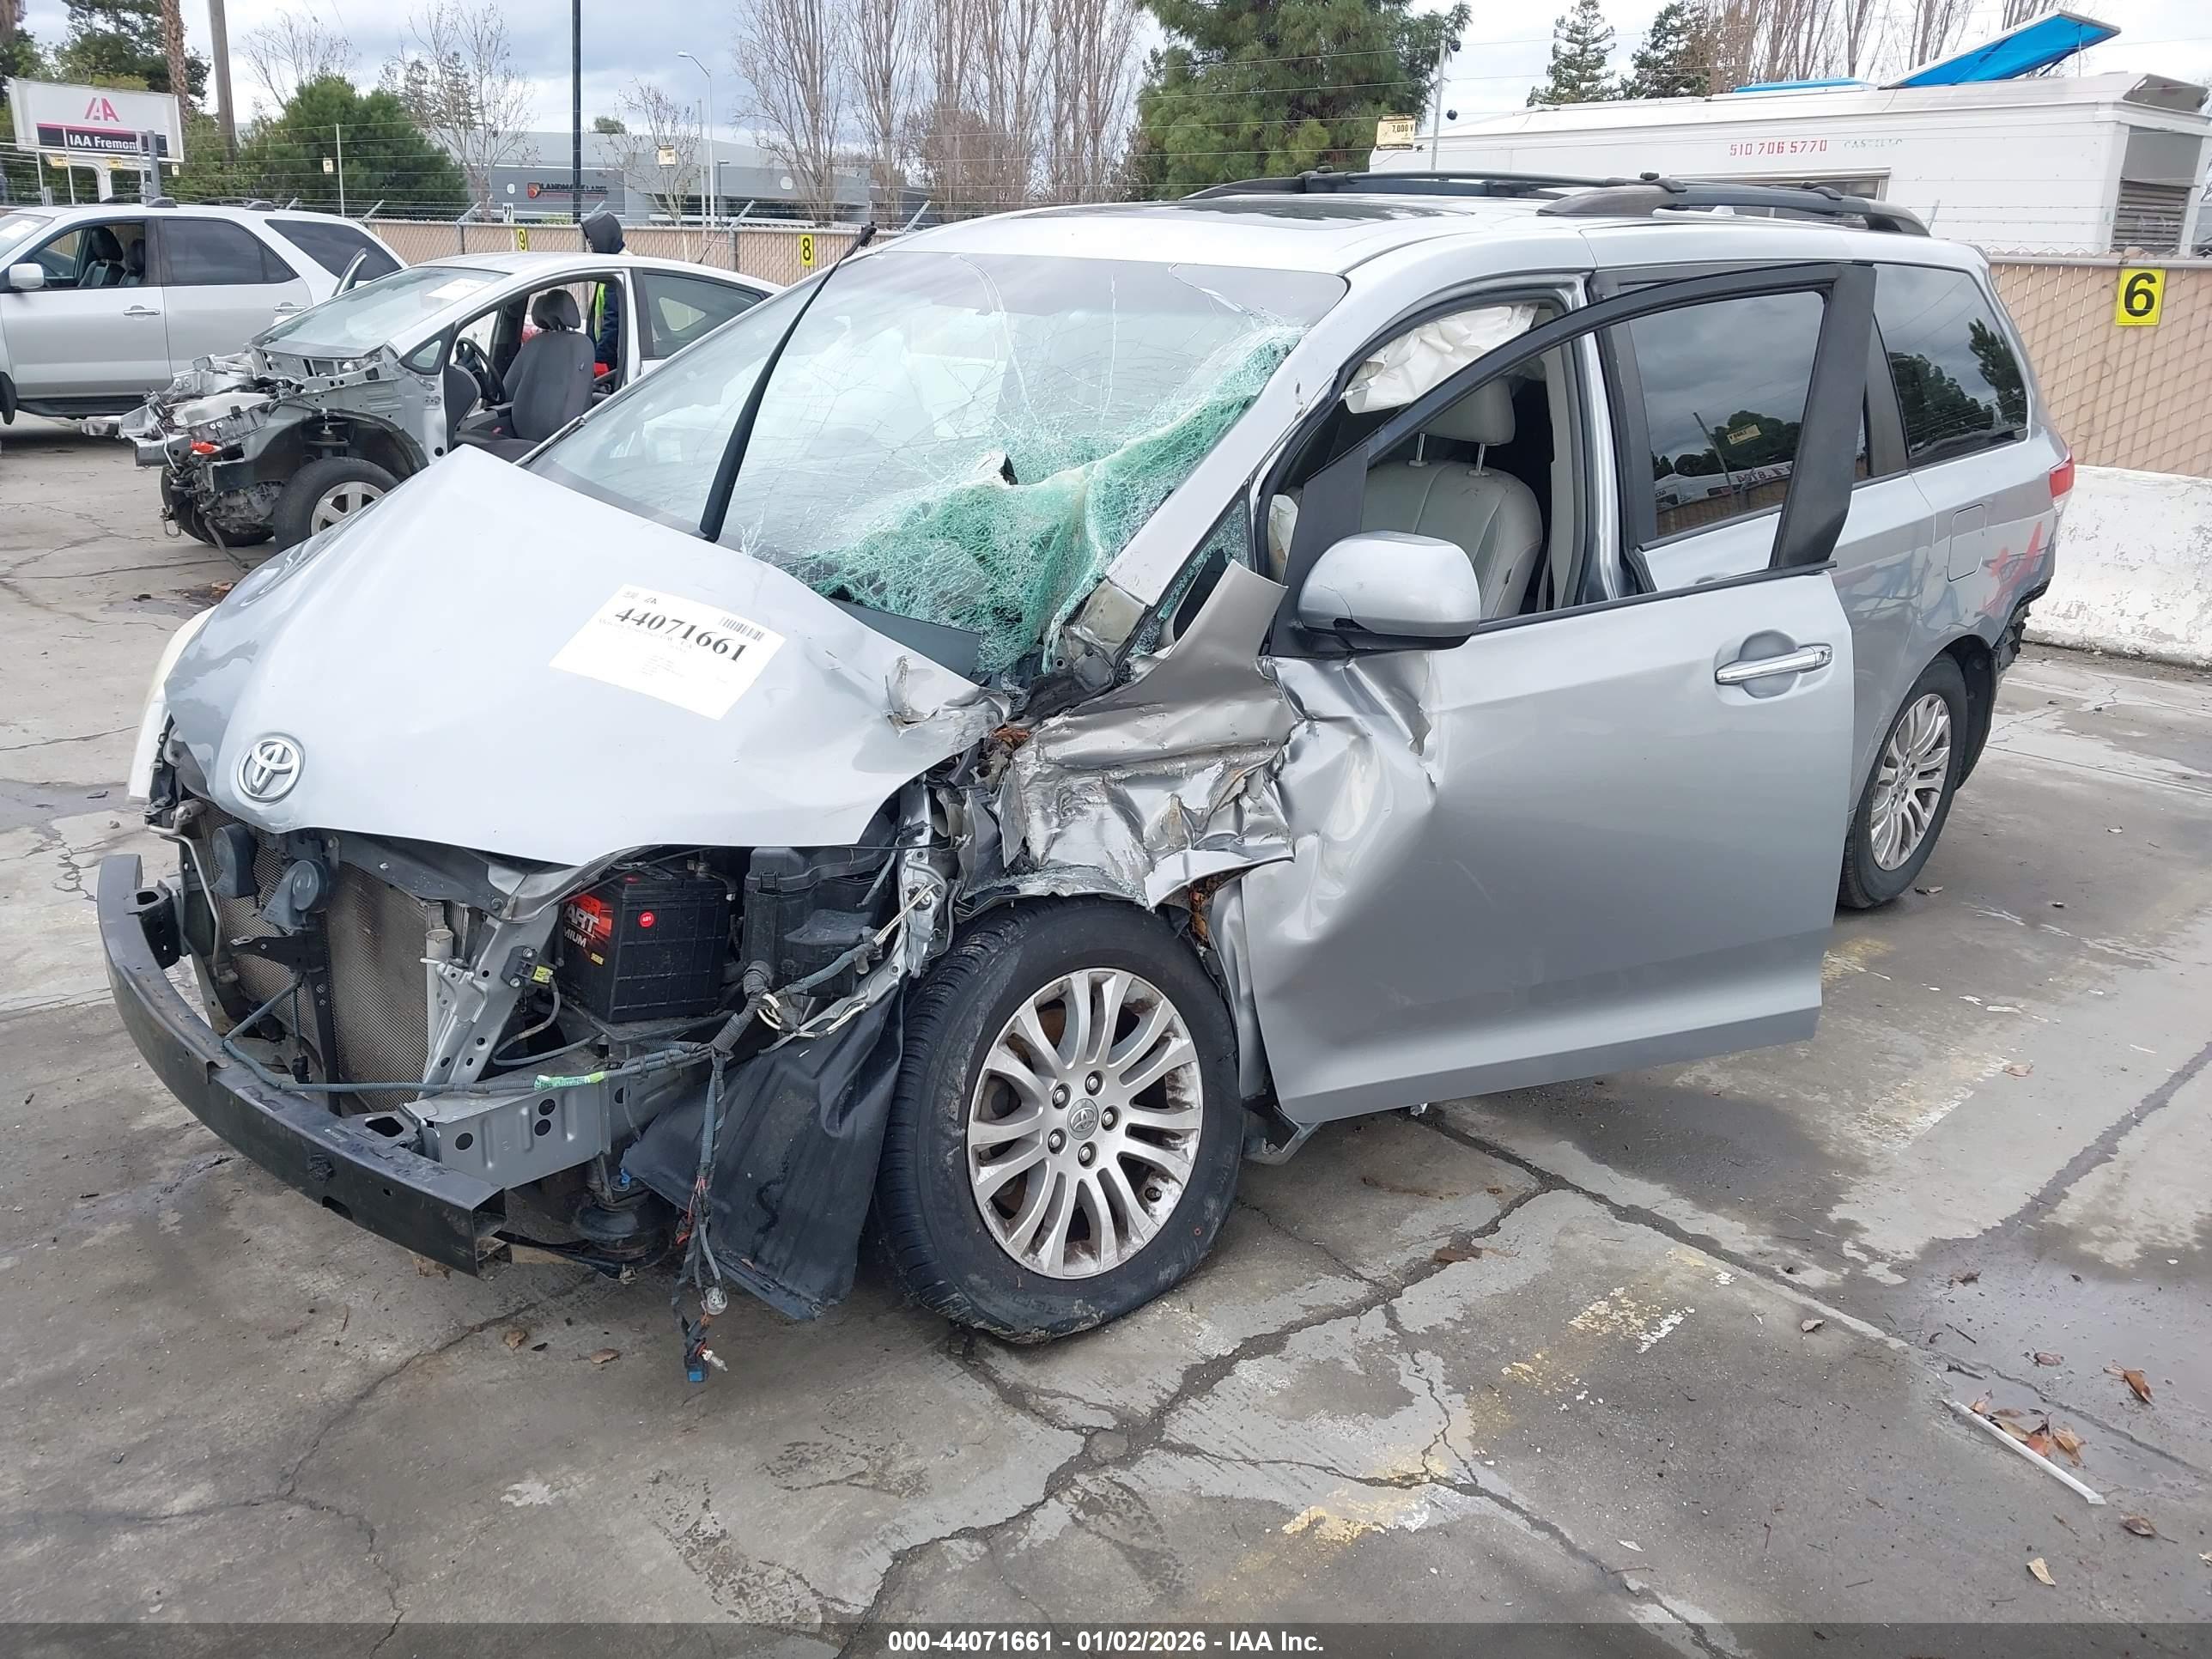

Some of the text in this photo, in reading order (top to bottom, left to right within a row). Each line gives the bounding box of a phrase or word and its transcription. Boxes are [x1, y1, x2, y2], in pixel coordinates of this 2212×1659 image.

[69, 134, 92, 148] IAA
[1730, 140, 1827, 156] 510 706 5770
[520, 231, 526, 250] 9
[803, 237, 811, 261] 8
[2124, 272, 2157, 317] 6
[615, 607, 747, 662] 44071661
